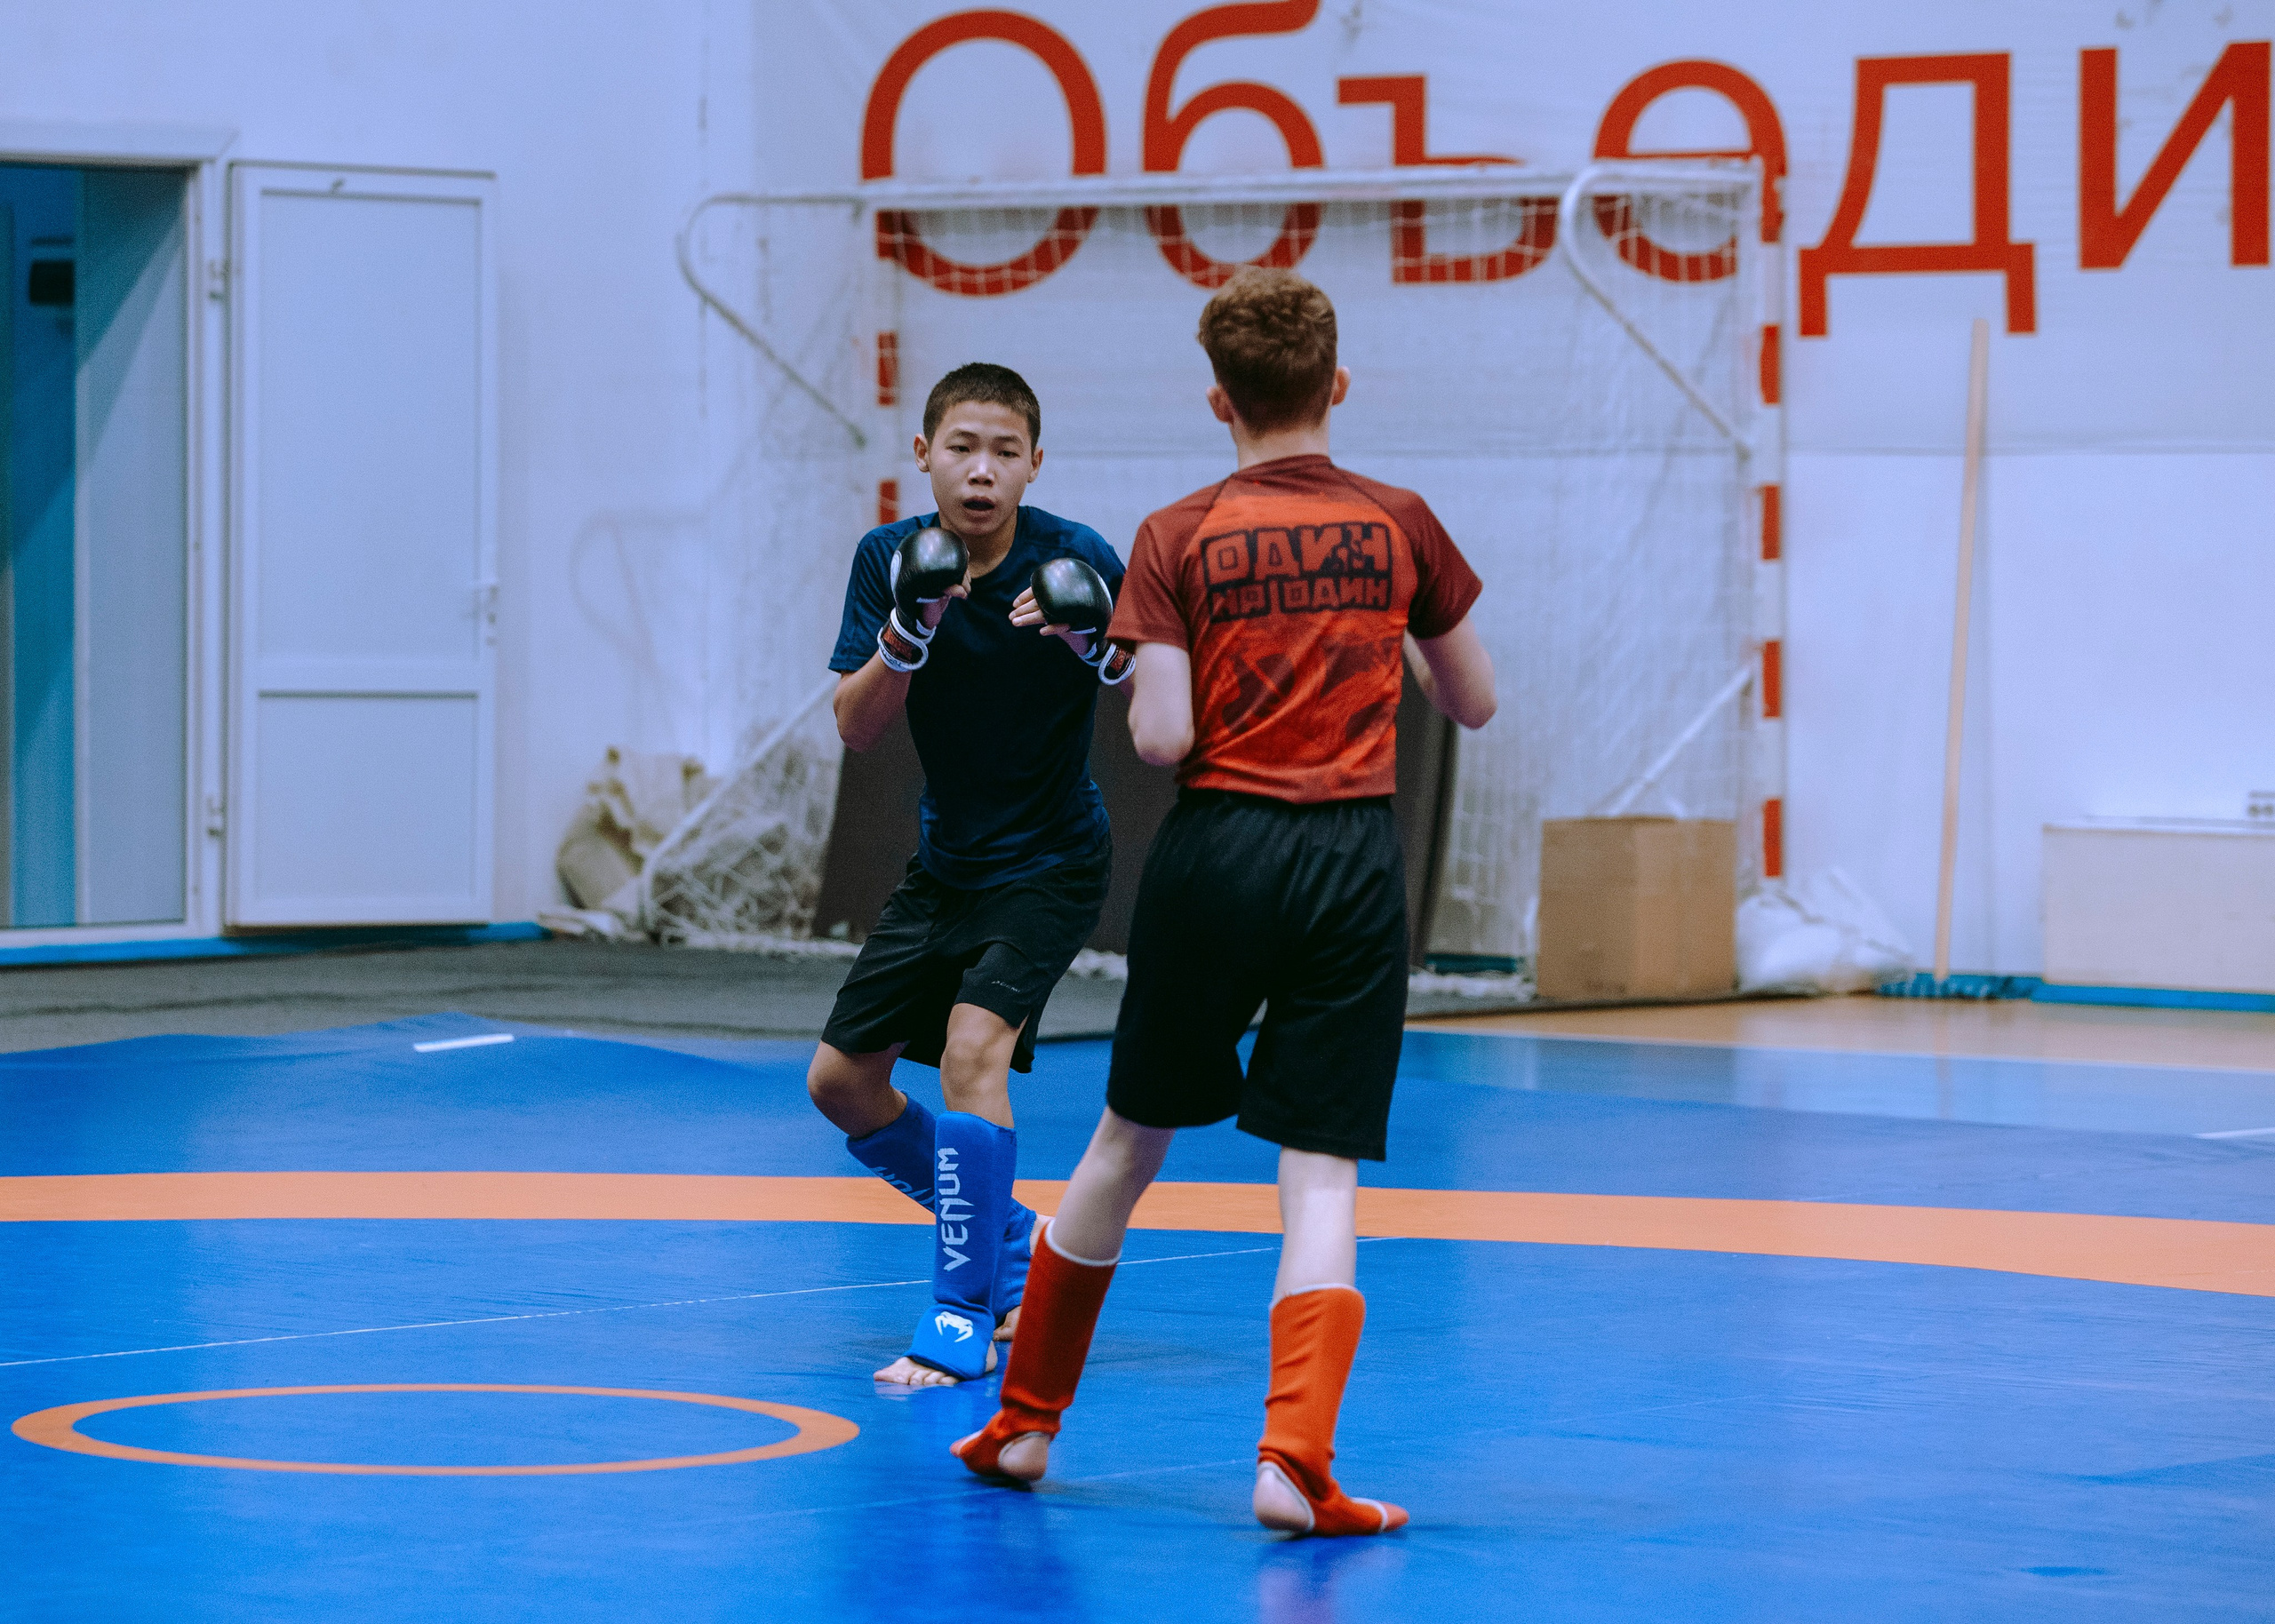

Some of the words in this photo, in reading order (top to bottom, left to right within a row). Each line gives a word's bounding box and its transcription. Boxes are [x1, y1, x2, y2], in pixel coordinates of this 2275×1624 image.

[1201, 521, 1392, 588] ОДИН
[1278, 576, 1391, 614] ОДИН
[937, 1146, 975, 1272] VENUM
